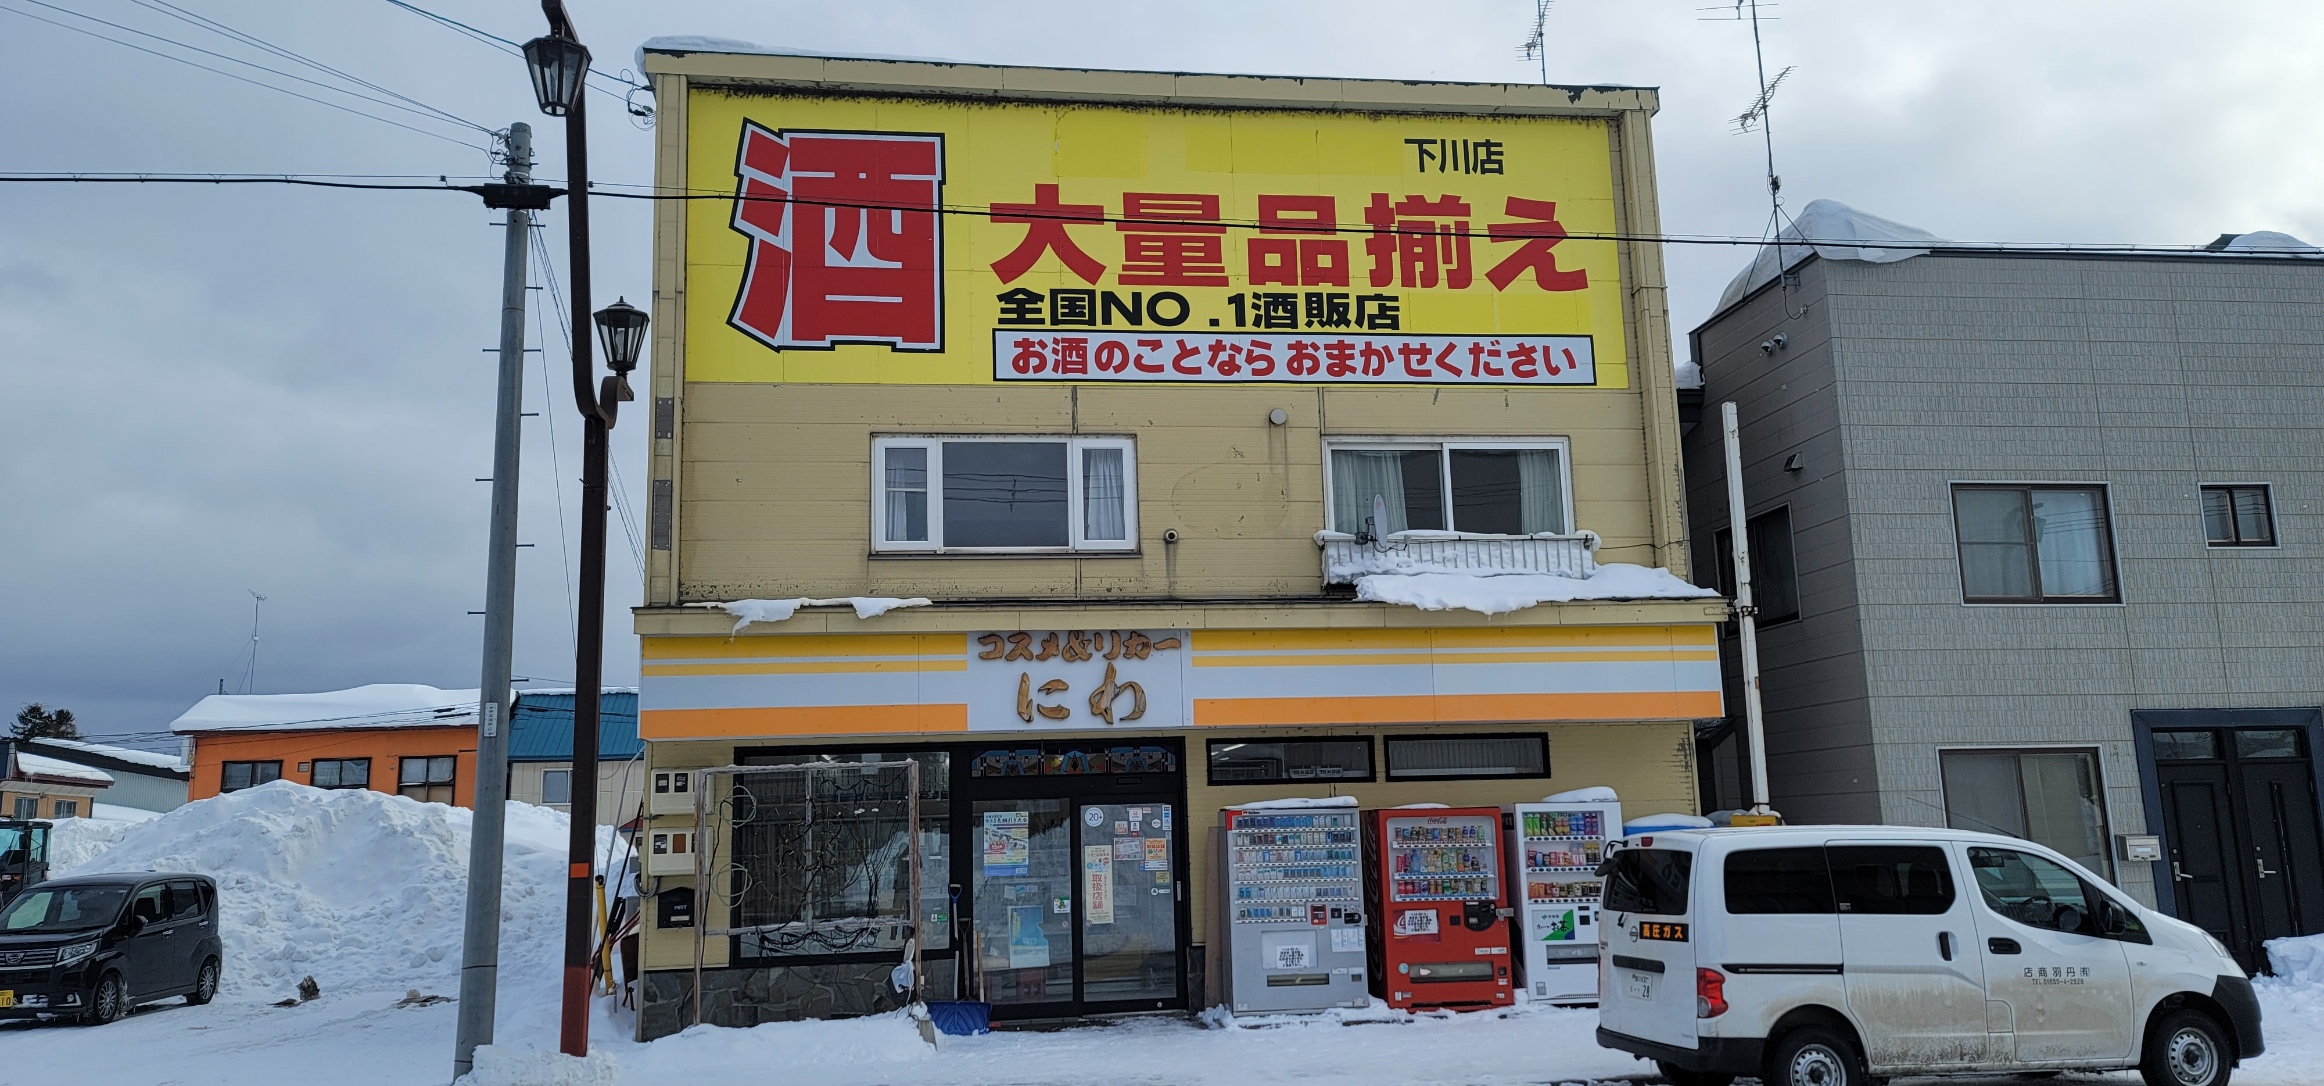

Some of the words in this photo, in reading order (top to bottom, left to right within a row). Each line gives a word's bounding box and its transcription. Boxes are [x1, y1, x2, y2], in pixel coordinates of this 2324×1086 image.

[1404, 138, 1505, 176] 下川店
[726, 117, 946, 353] 酒
[988, 183, 1589, 293] 大量品揃え
[977, 630, 1182, 662] コスメ&リカー
[1016, 661, 1147, 725] にわ
[1091, 873, 1104, 910] 取扱店舗
[1642, 923, 1684, 939] 高圧ガス
